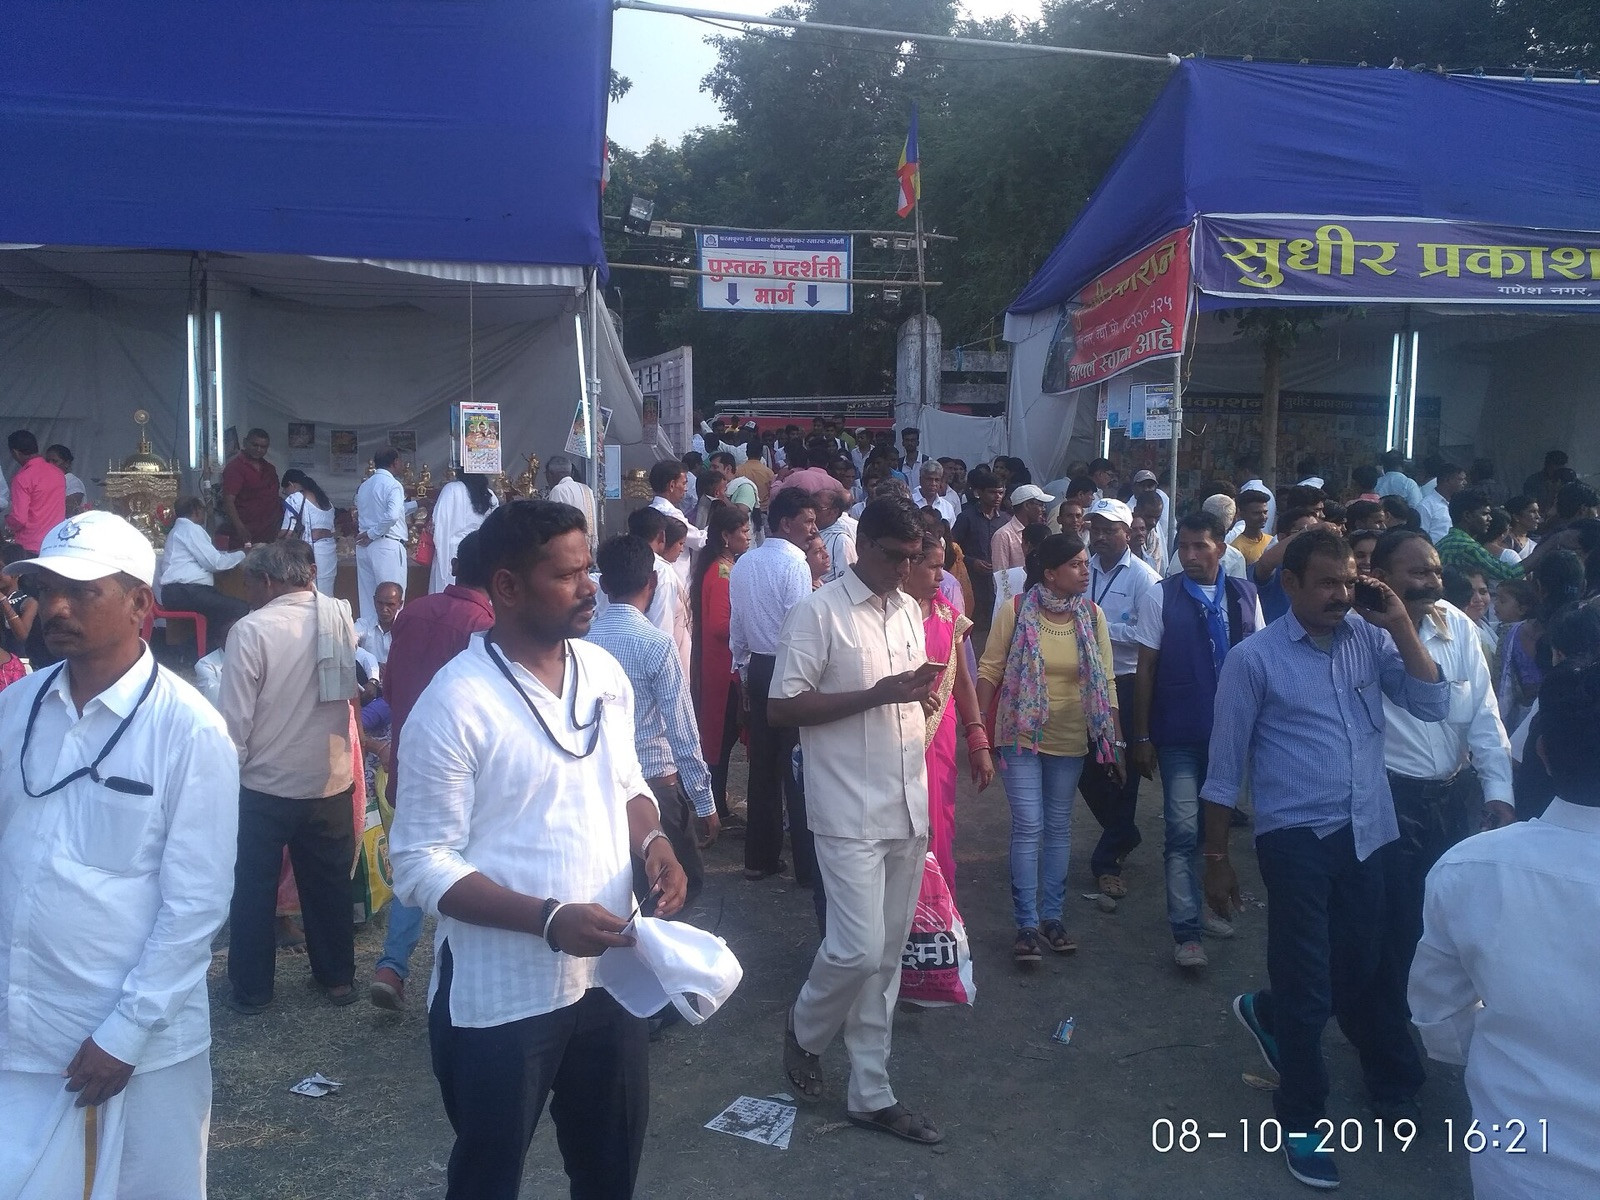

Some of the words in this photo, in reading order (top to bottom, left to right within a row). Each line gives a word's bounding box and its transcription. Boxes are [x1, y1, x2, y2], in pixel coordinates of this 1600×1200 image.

[708, 258, 767, 282] पुस्तक
[773, 255, 842, 279] प्रदर्शनी
[1219, 225, 1400, 288] सुधीर
[754, 282, 796, 305] मार्ग
[1497, 284, 1543, 295] गणेश
[1550, 287, 1593, 297] नगर,
[1135, 318, 1174, 355] आहे
